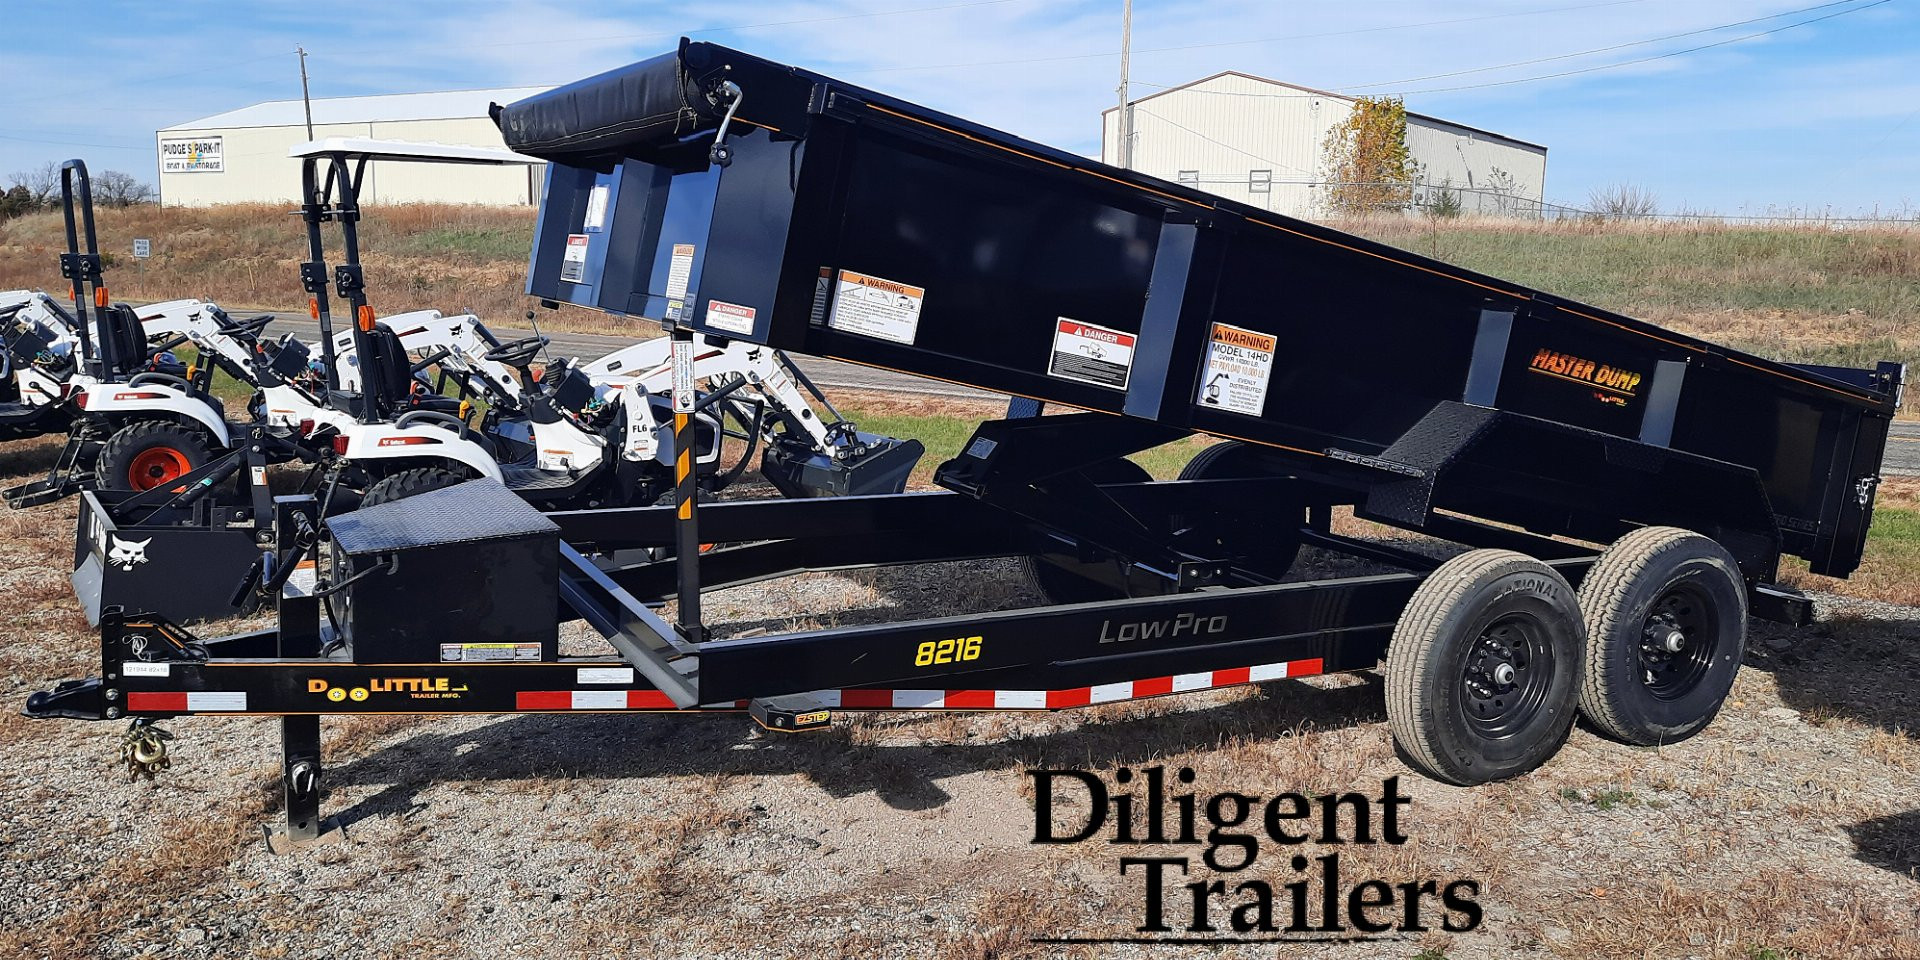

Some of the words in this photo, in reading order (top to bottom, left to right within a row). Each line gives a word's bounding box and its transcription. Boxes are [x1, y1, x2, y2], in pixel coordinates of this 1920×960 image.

[867, 278, 905, 294] WARNING
[721, 305, 748, 317] DANGER
[1084, 328, 1118, 344] DANGER
[1224, 330, 1270, 350] WARNING
[1212, 343, 1244, 358] MODEL
[1246, 351, 1269, 363] 14HD
[1531, 347, 1597, 380] MASTER
[1595, 364, 1642, 391] DUMP
[632, 424, 648, 433] FL6
[914, 636, 983, 667] 8216
